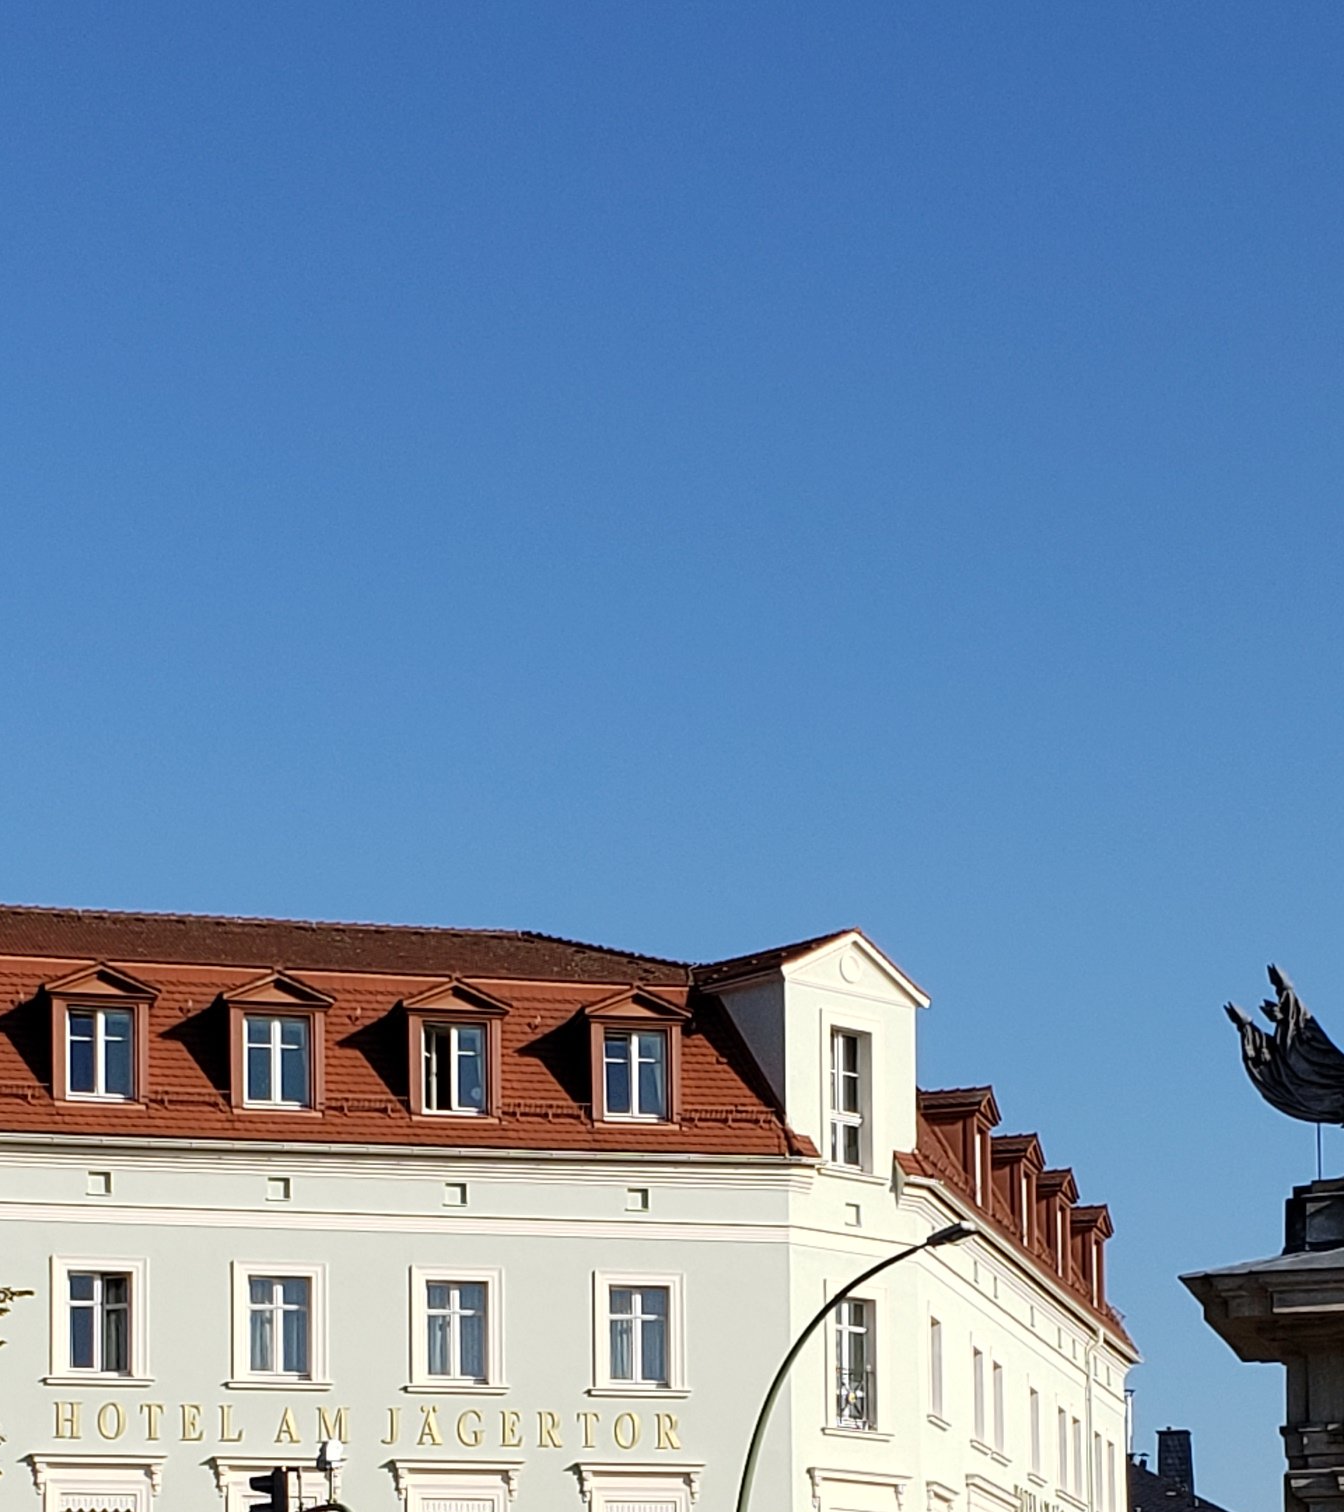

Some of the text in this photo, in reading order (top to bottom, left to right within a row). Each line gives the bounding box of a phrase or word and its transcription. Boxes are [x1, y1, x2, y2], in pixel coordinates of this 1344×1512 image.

[53, 1401, 682, 1450] HOTEL AM JÄGERTOR
